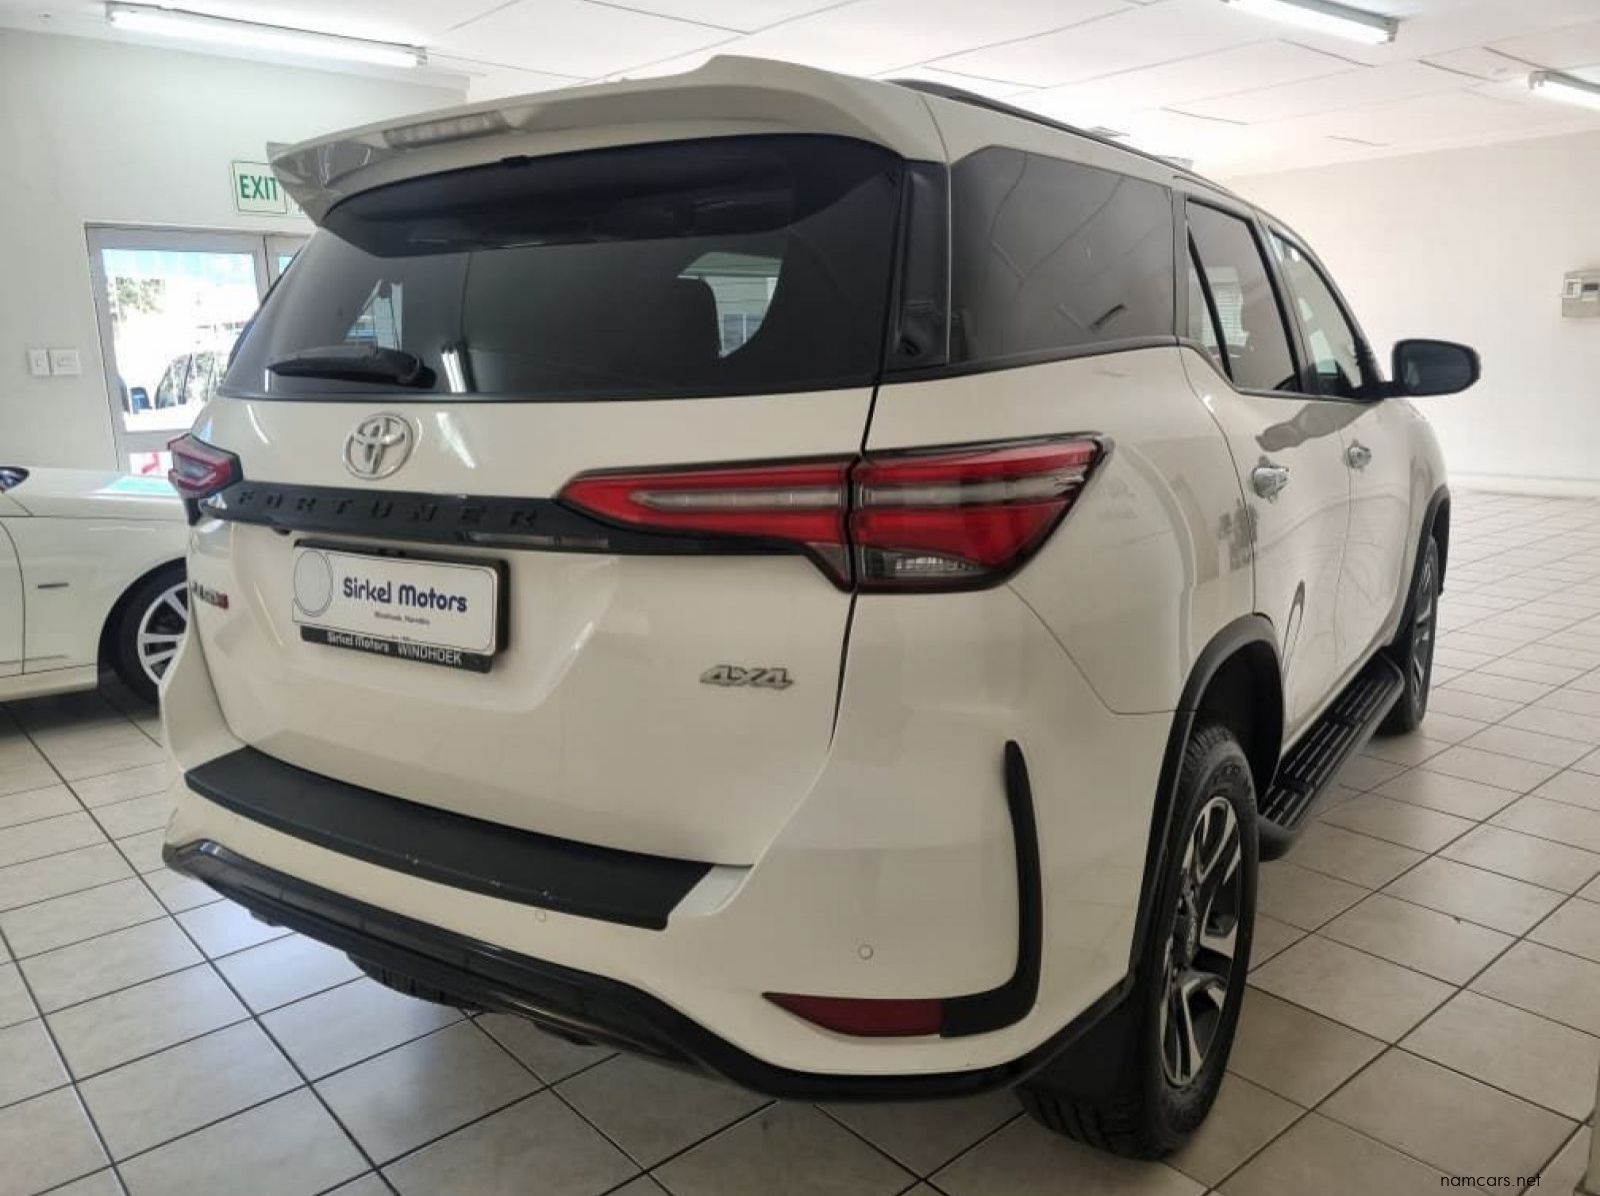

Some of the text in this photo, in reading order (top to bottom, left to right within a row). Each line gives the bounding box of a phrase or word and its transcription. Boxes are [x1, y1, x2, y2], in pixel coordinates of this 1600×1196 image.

[240, 175, 277, 201] EXIT
[238, 490, 538, 528] FORTUNER
[342, 576, 468, 613] Sirkel Motors
[398, 643, 464, 666] WINDHOEK
